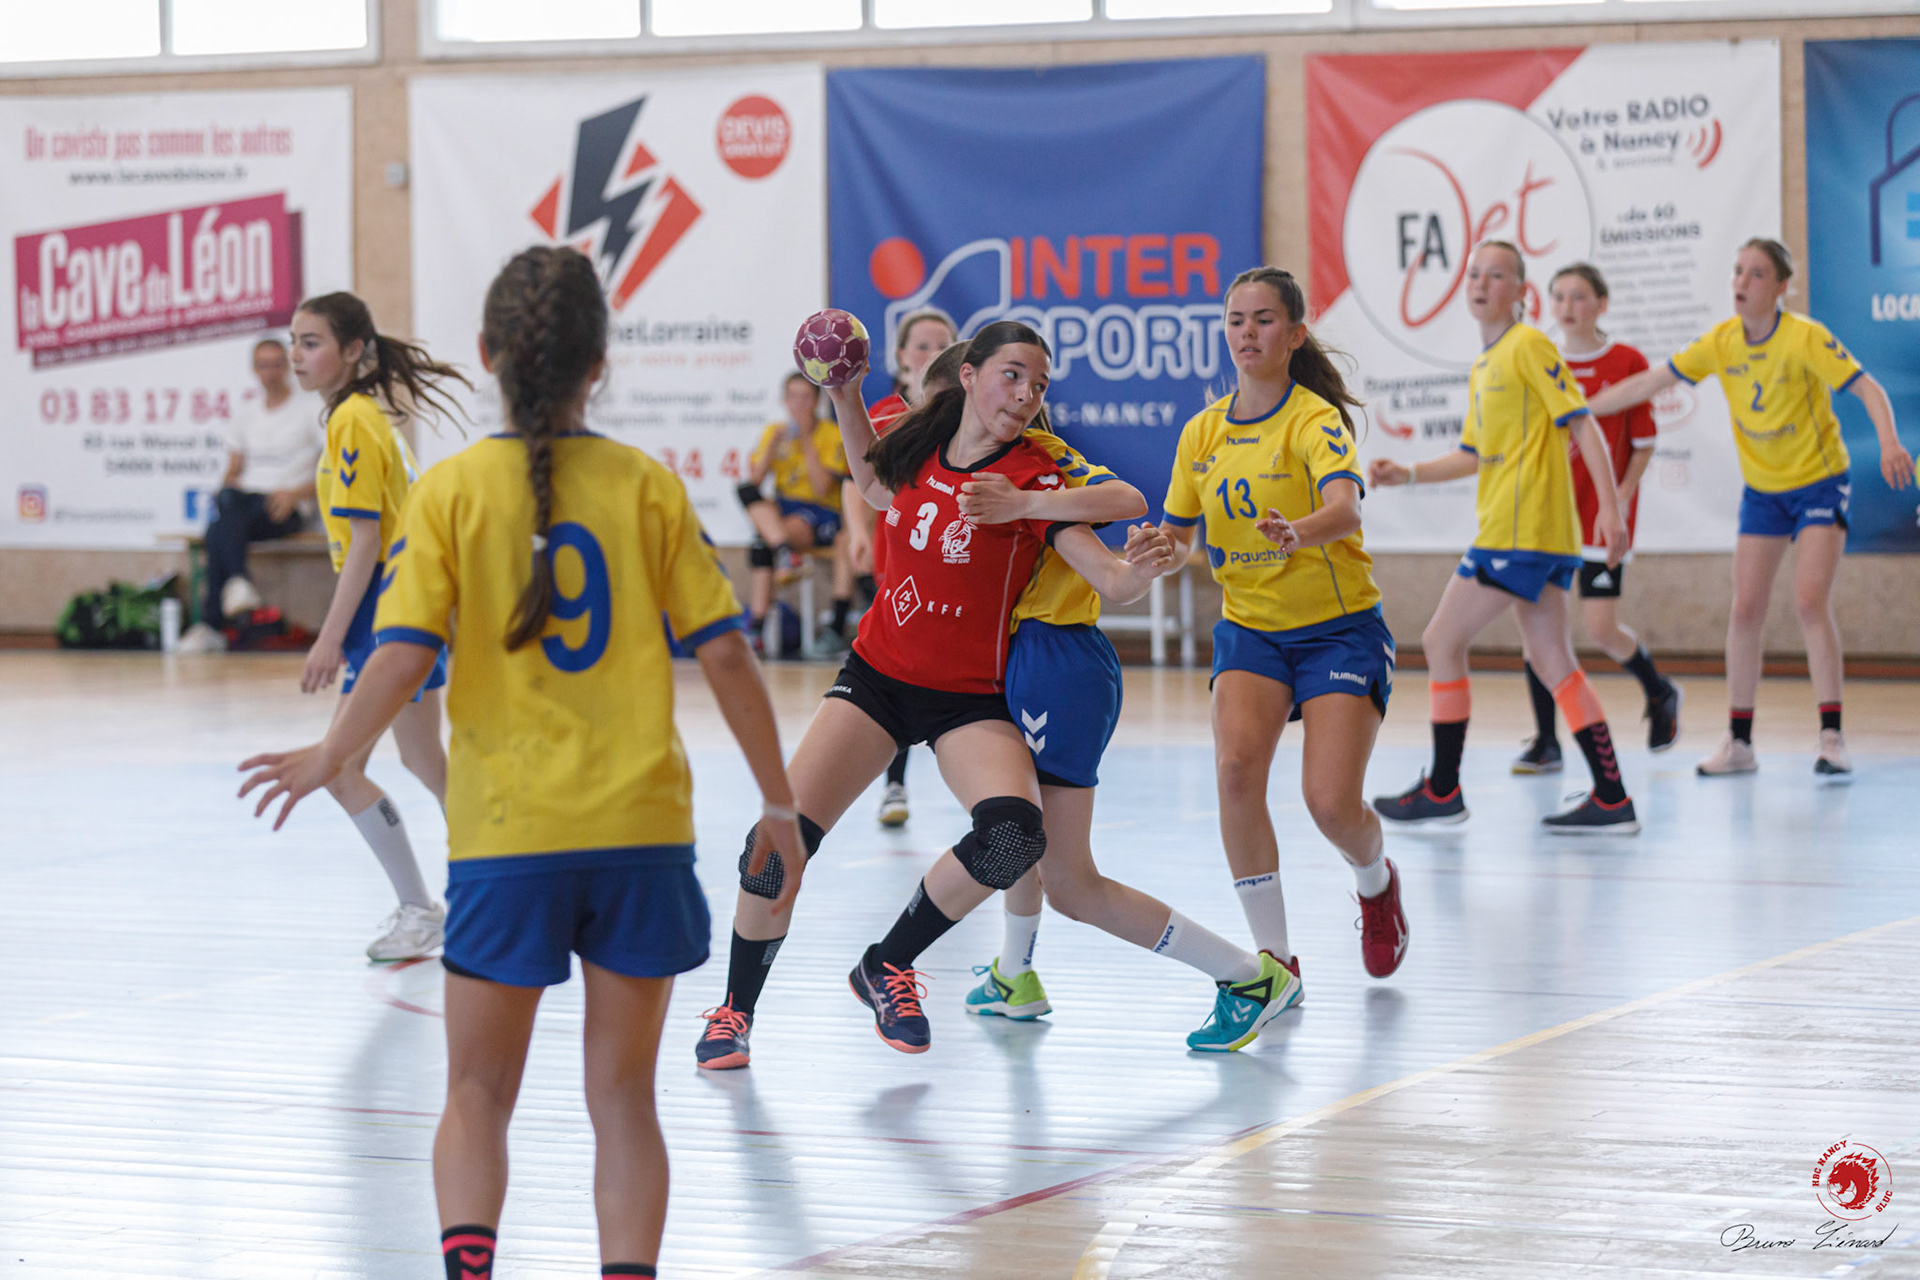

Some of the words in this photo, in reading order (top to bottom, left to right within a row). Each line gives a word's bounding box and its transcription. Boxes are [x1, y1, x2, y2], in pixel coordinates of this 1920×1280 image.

[721, 115, 786, 142] DEVIS
[1547, 107, 1619, 132] Votre
[1627, 95, 1708, 125] RADIO
[1604, 131, 1681, 153] Nancy
[39, 231, 143, 329] Cave
[167, 206, 274, 309] Léon
[1010, 233, 1221, 299] INTER
[40, 388, 79, 424] 03
[91, 388, 131, 424] 83
[144, 388, 180, 423] 17
[191, 388, 232, 424] 84
[1751, 380, 1765, 412] 2
[1053, 401, 1177, 427] S-NANCY
[1226, 435, 1260, 446] hummel
[926, 475, 955, 496] hummel
[1216, 477, 1258, 520] 13
[909, 502, 939, 552] 3
[541, 520, 613, 674] 9
[1329, 669, 1367, 686] hummel
[1234, 875, 1273, 888] mpa
[1155, 924, 1175, 953] mpa
